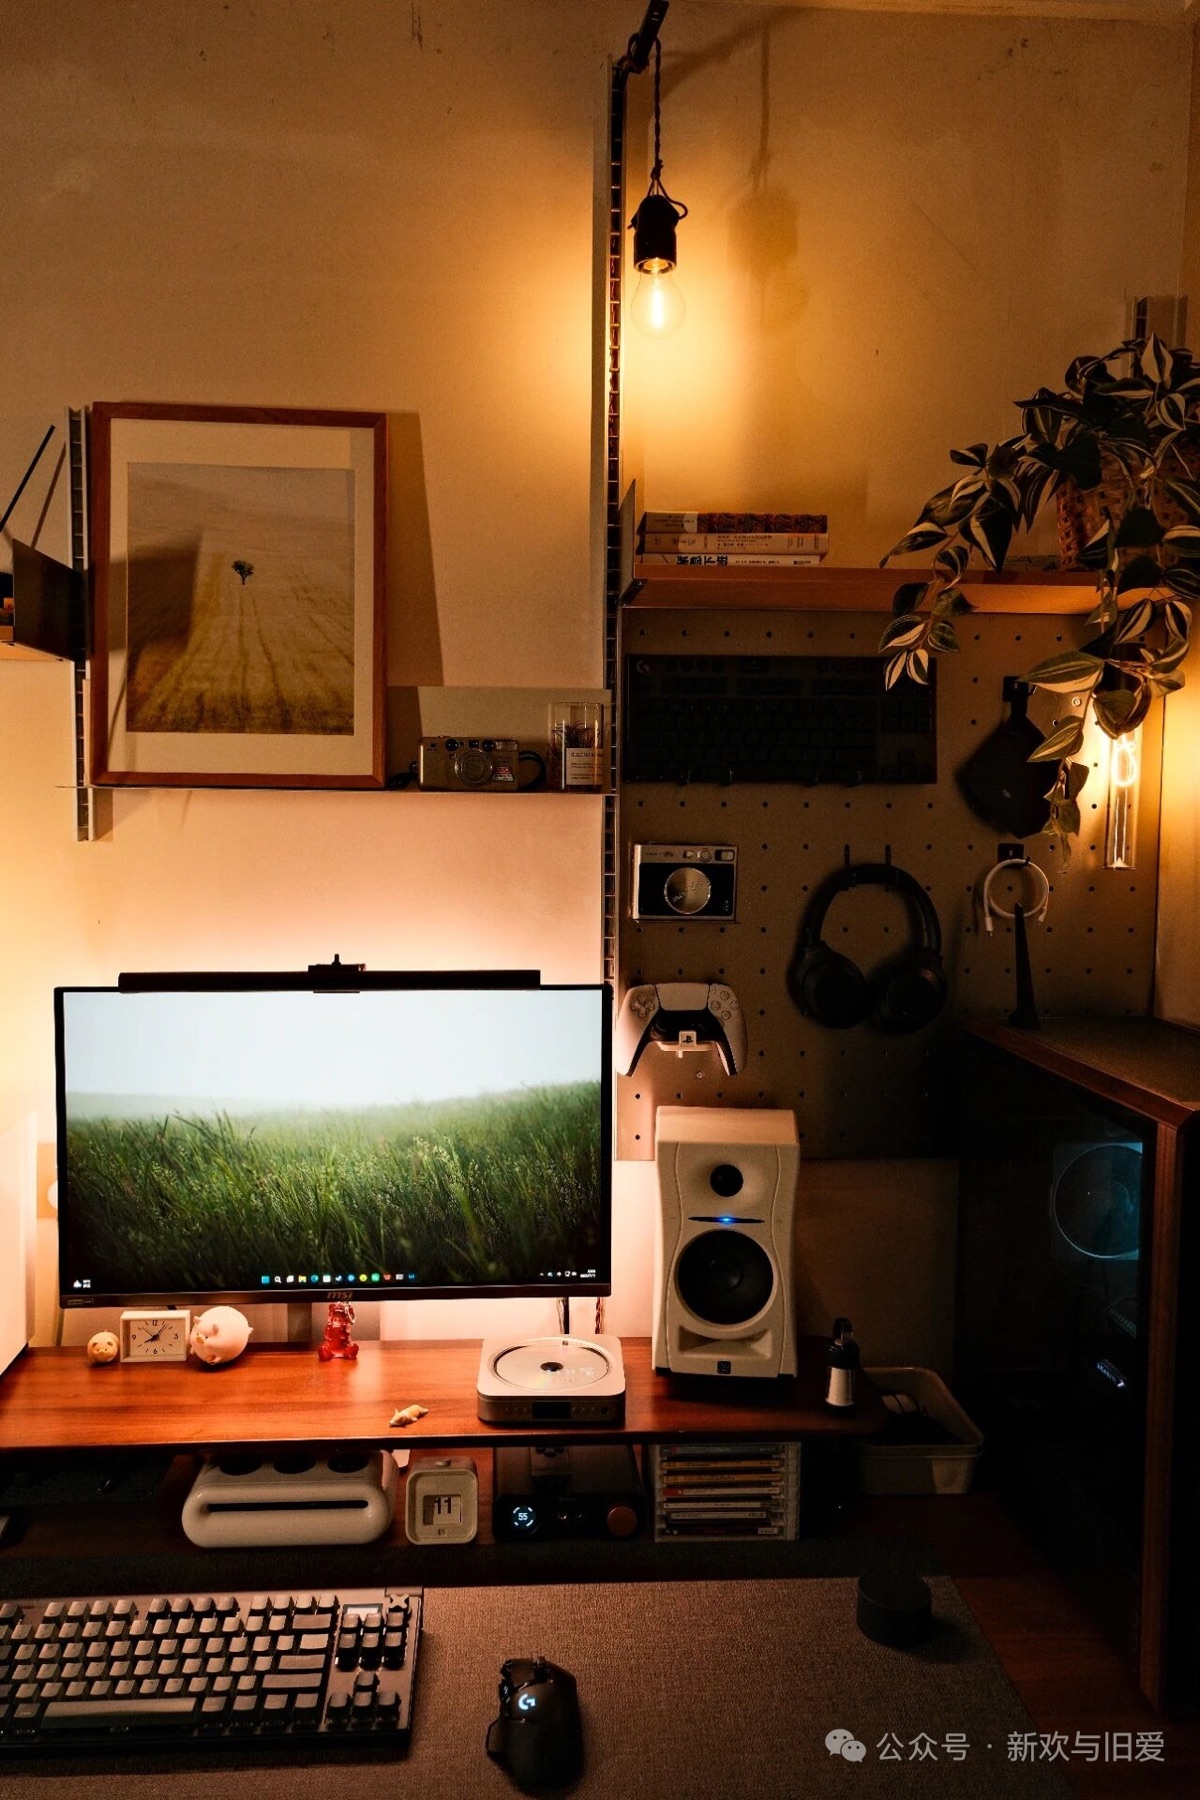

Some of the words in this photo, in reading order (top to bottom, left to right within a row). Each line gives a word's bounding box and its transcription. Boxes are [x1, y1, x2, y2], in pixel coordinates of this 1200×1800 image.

[327, 1290, 353, 1300] msi
[151, 1319, 159, 1327] 12
[434, 1495, 452, 1515] 11
[517, 1512, 529, 1522] 55
